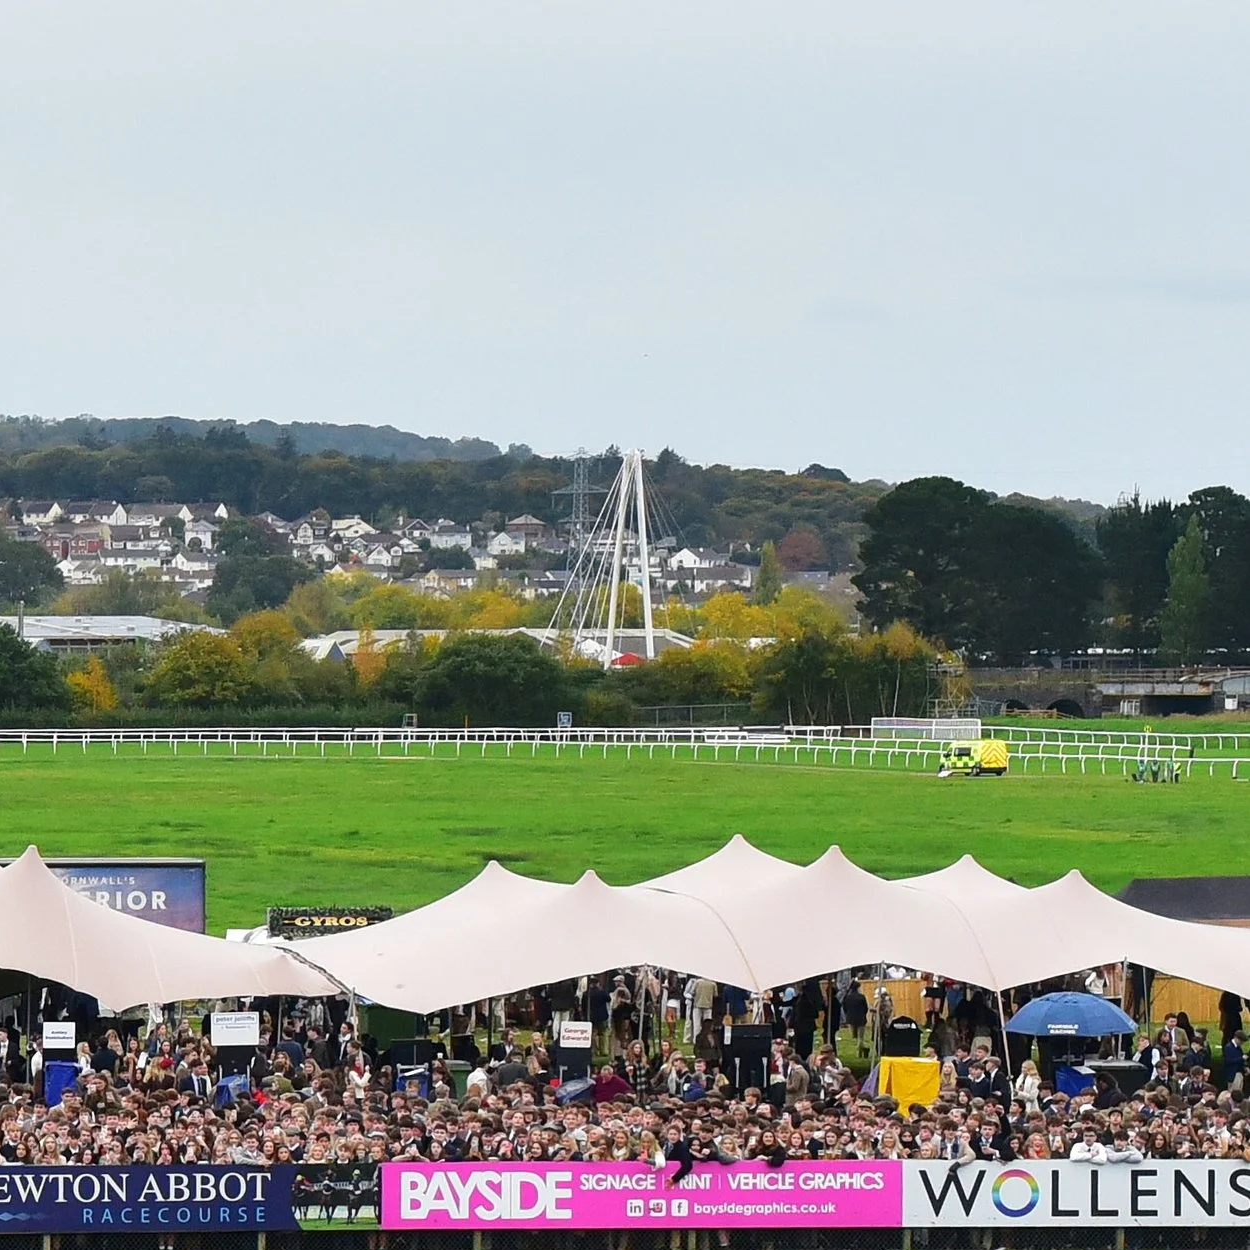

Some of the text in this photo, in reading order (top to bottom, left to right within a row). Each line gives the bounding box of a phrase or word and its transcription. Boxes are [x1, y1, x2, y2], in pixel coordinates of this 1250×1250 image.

[294, 916, 368, 927] GYROS
[564, 1027, 588, 1035] George
[138, 1172, 271, 1202] ABBOT
[580, 1172, 885, 1190] SIGNAGE RINT VEHICLE GRAPHICS
[400, 1171, 573, 1220] BAYSIDE
[918, 1168, 1250, 1218] WOLLENS
[83, 1207, 266, 1224] RACECOURSE
[694, 1202, 837, 1216] baysidegraphics.co.uk
